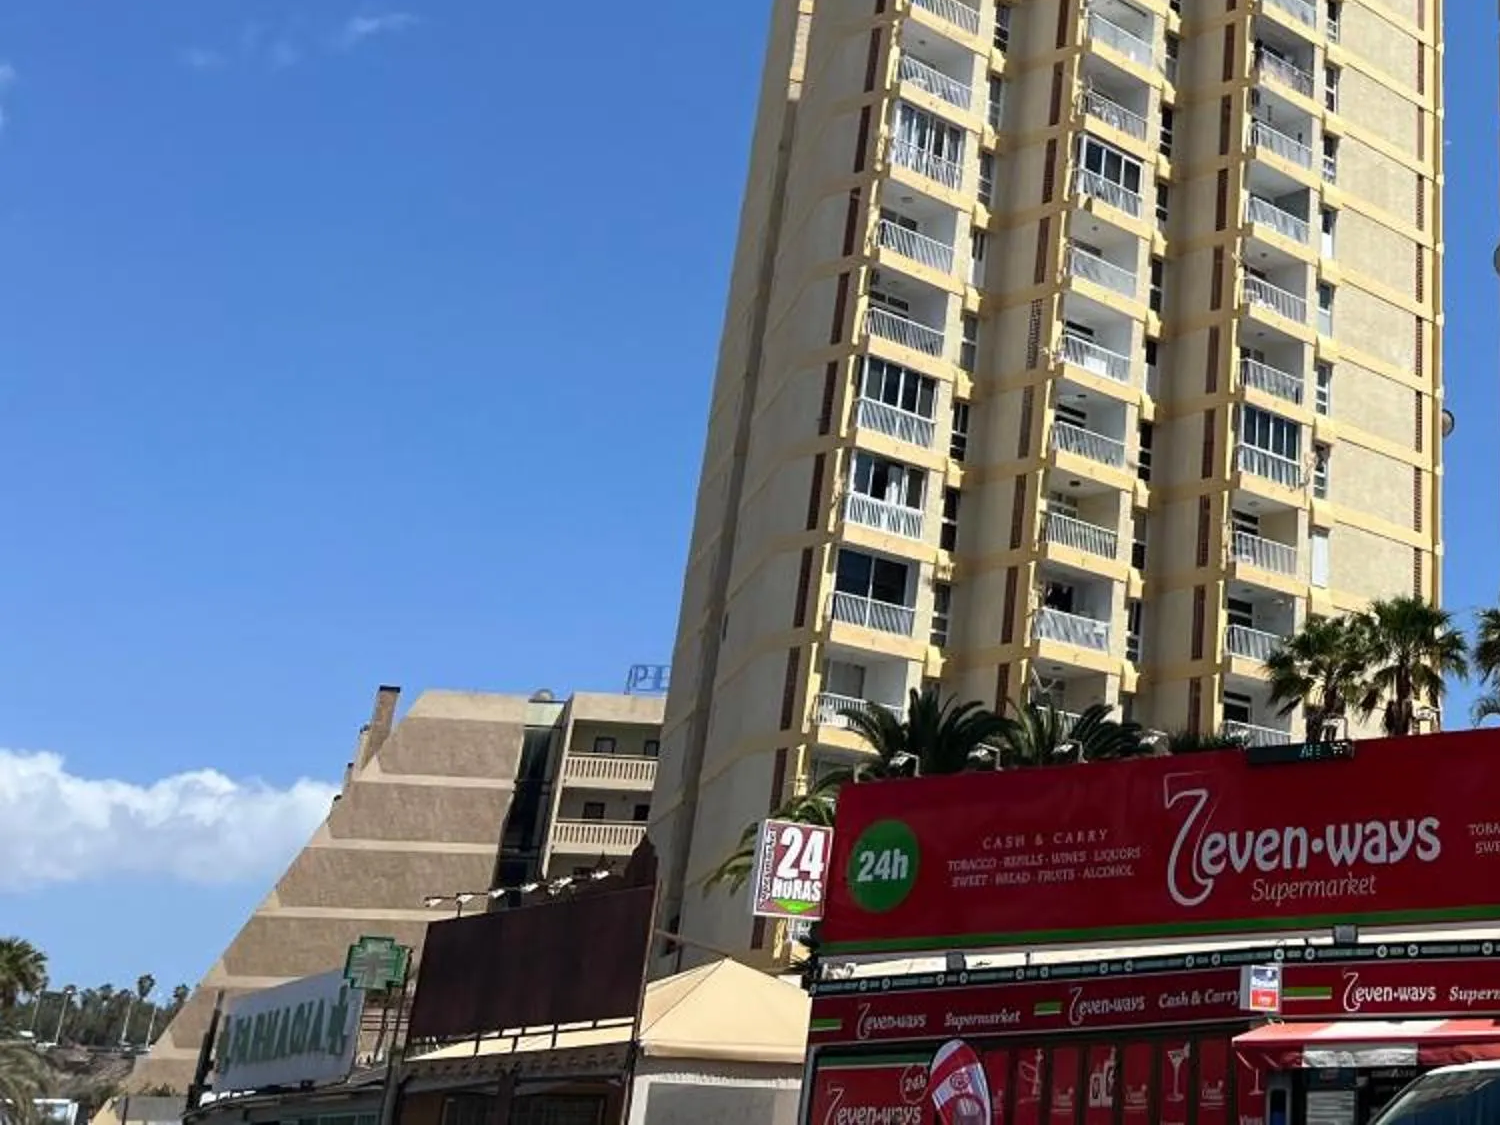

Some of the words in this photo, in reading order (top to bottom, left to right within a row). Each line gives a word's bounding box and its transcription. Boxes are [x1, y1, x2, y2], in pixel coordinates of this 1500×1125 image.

[982, 835, 1025, 850] CASH
[1034, 833, 1043, 846] &
[1053, 829, 1109, 844] CARRY
[776, 827, 825, 880] 24
[857, 848, 910, 882] 24h
[947, 859, 997, 872] TOBACCO
[772, 878, 822, 902] HORAS
[1251, 871, 1377, 907] Supermarket
[1158, 991, 1189, 1008] Cash
[1204, 988, 1240, 1007] Carry
[944, 1008, 1022, 1031] Supermarket
